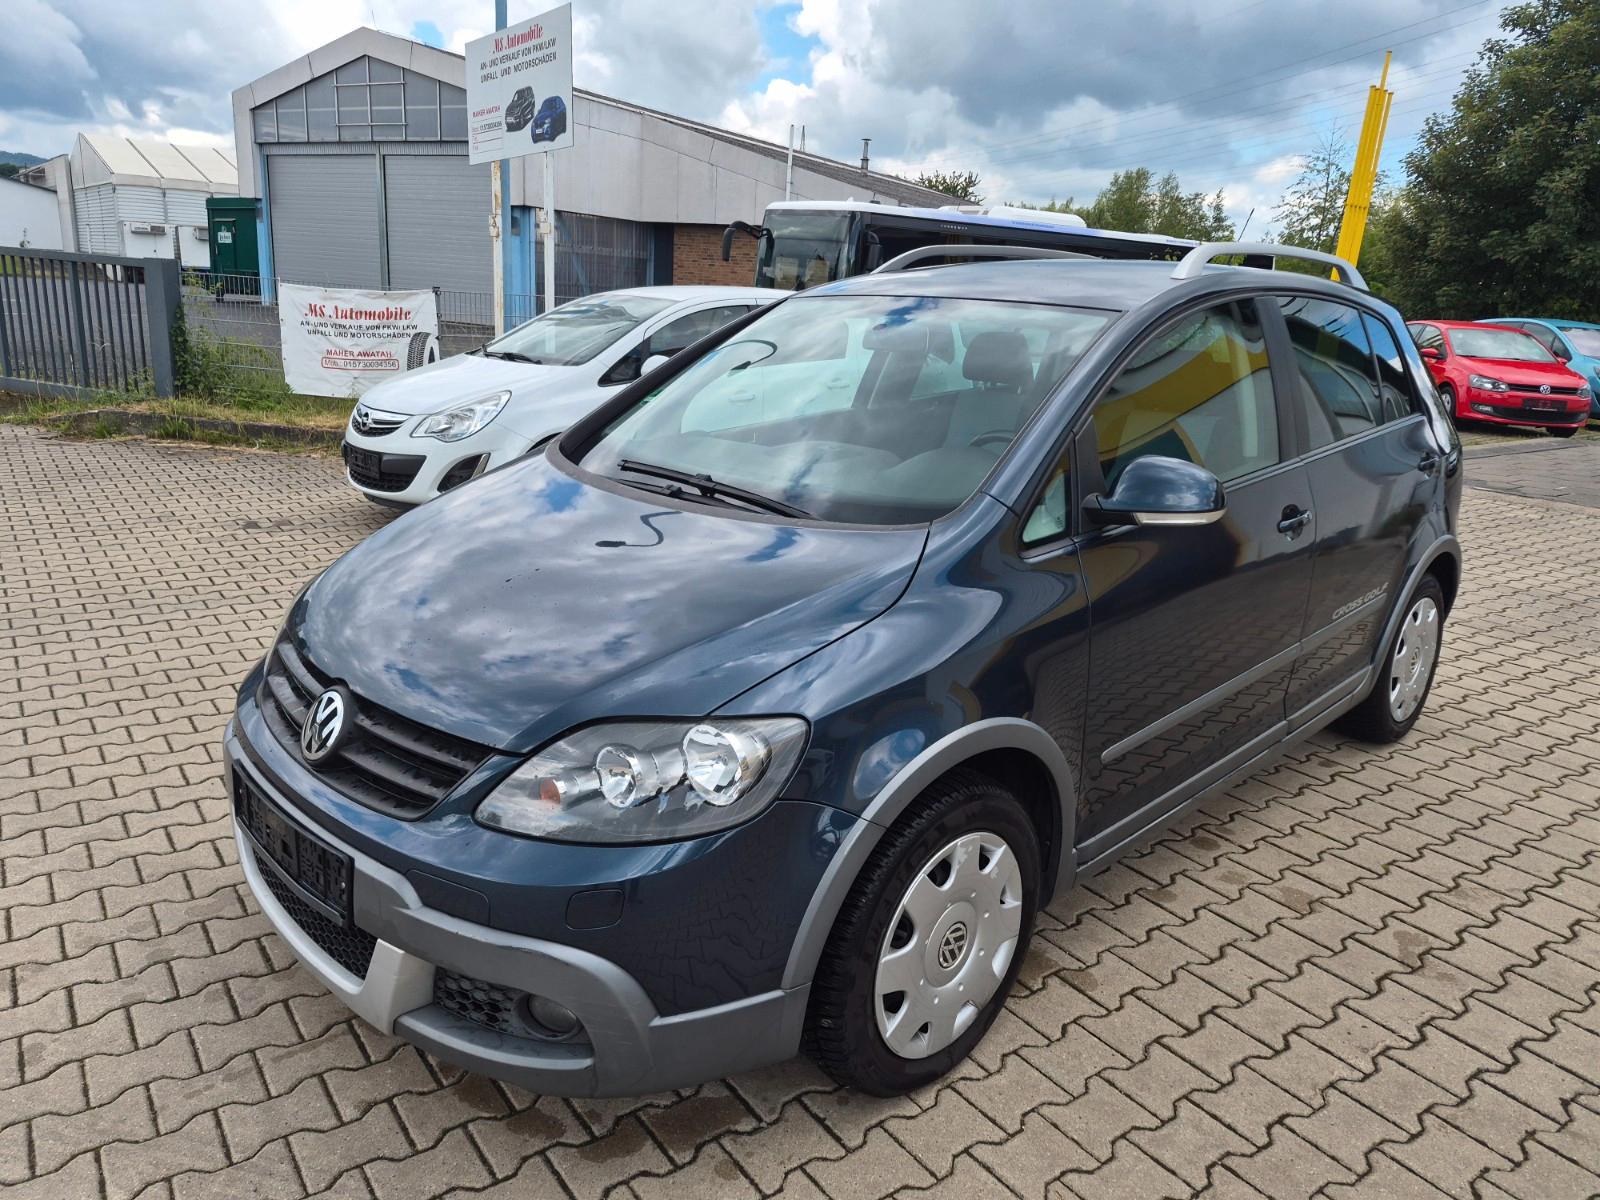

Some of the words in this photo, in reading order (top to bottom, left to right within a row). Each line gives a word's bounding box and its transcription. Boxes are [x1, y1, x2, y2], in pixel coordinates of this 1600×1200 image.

[492, 37, 504, 54] MS
[504, 23, 544, 50] Automobile
[489, 58, 499, 69] UND
[500, 49, 521, 65] VERKAUF
[521, 46, 532, 58] VON
[480, 71, 498, 84] UNFALL
[500, 66, 512, 77] UND
[513, 51, 557, 73] MOTORSCHÄDEN
[304, 303, 326, 318] MS
[329, 305, 411, 321] Automobile
[307, 329, 332, 337] UNFALL
[333, 330, 349, 338] UND
[350, 330, 411, 339] MOTORSCHÄDEN
[330, 323, 363, 331] VERKAUF
[326, 349, 355, 358] MAHER
[356, 350, 392, 358] AWATAH
